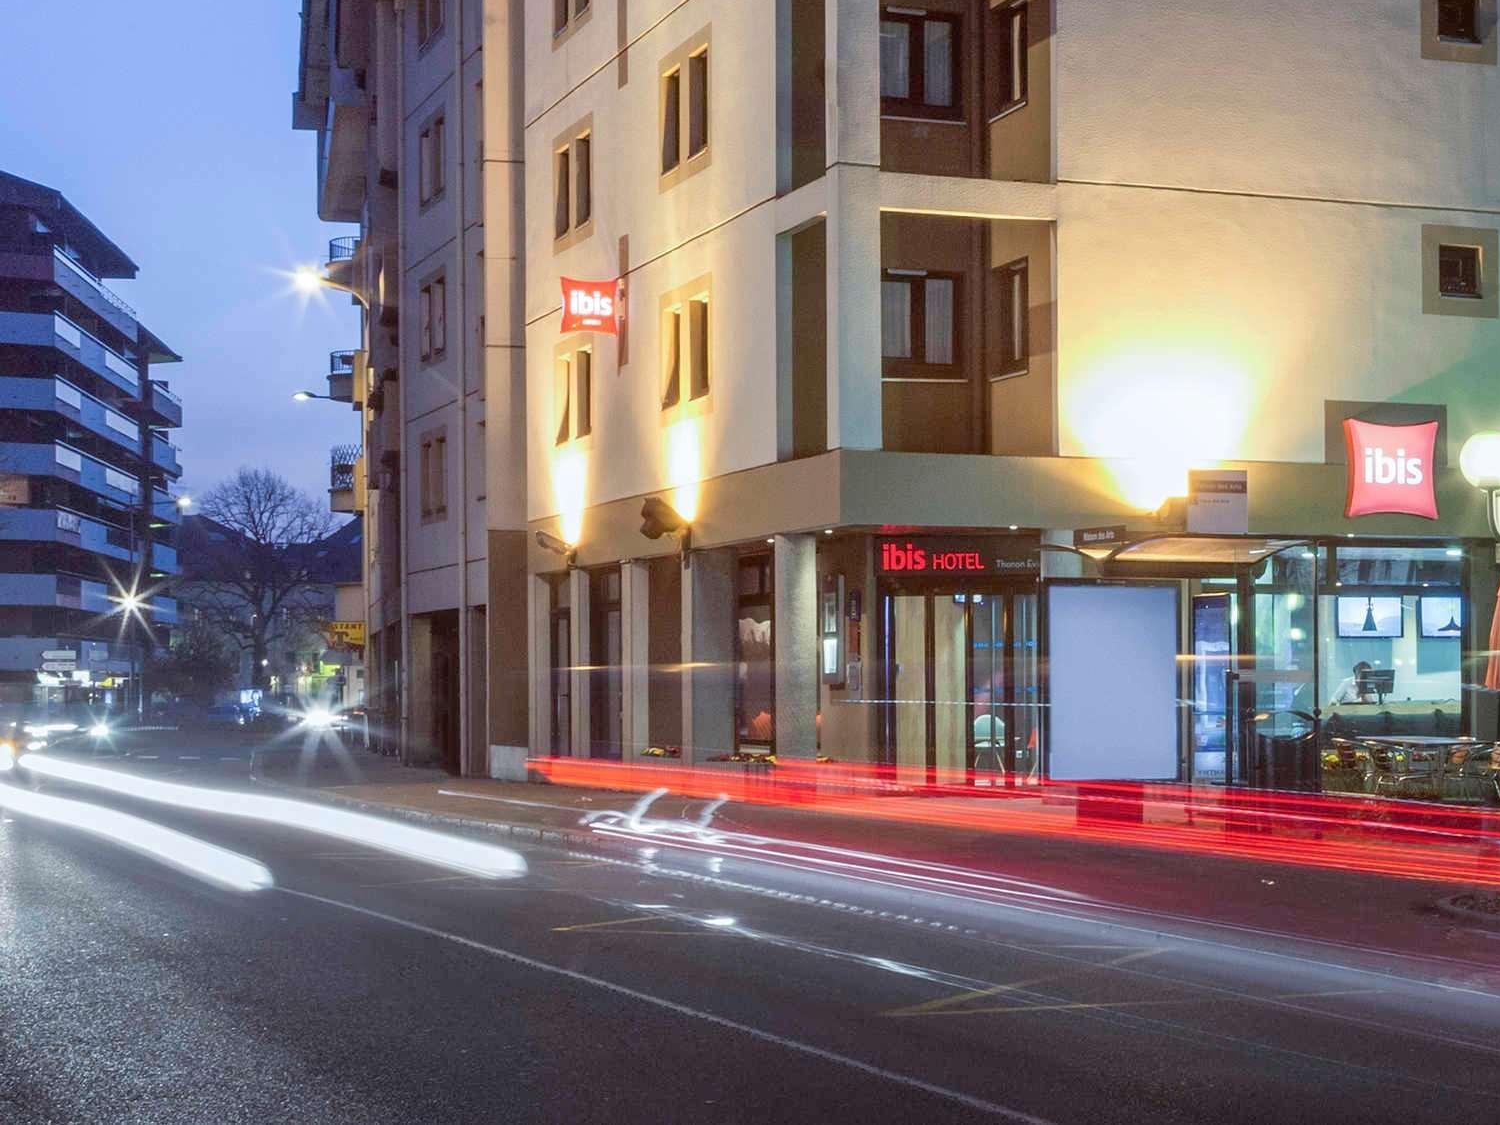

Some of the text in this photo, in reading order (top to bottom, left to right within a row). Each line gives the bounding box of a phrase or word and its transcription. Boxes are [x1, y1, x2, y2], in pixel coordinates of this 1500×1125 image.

[570, 289, 613, 317] ibis
[1364, 447, 1424, 485] ibis
[882, 543, 925, 570] ibis
[932, 553, 985, 570] HOTEL
